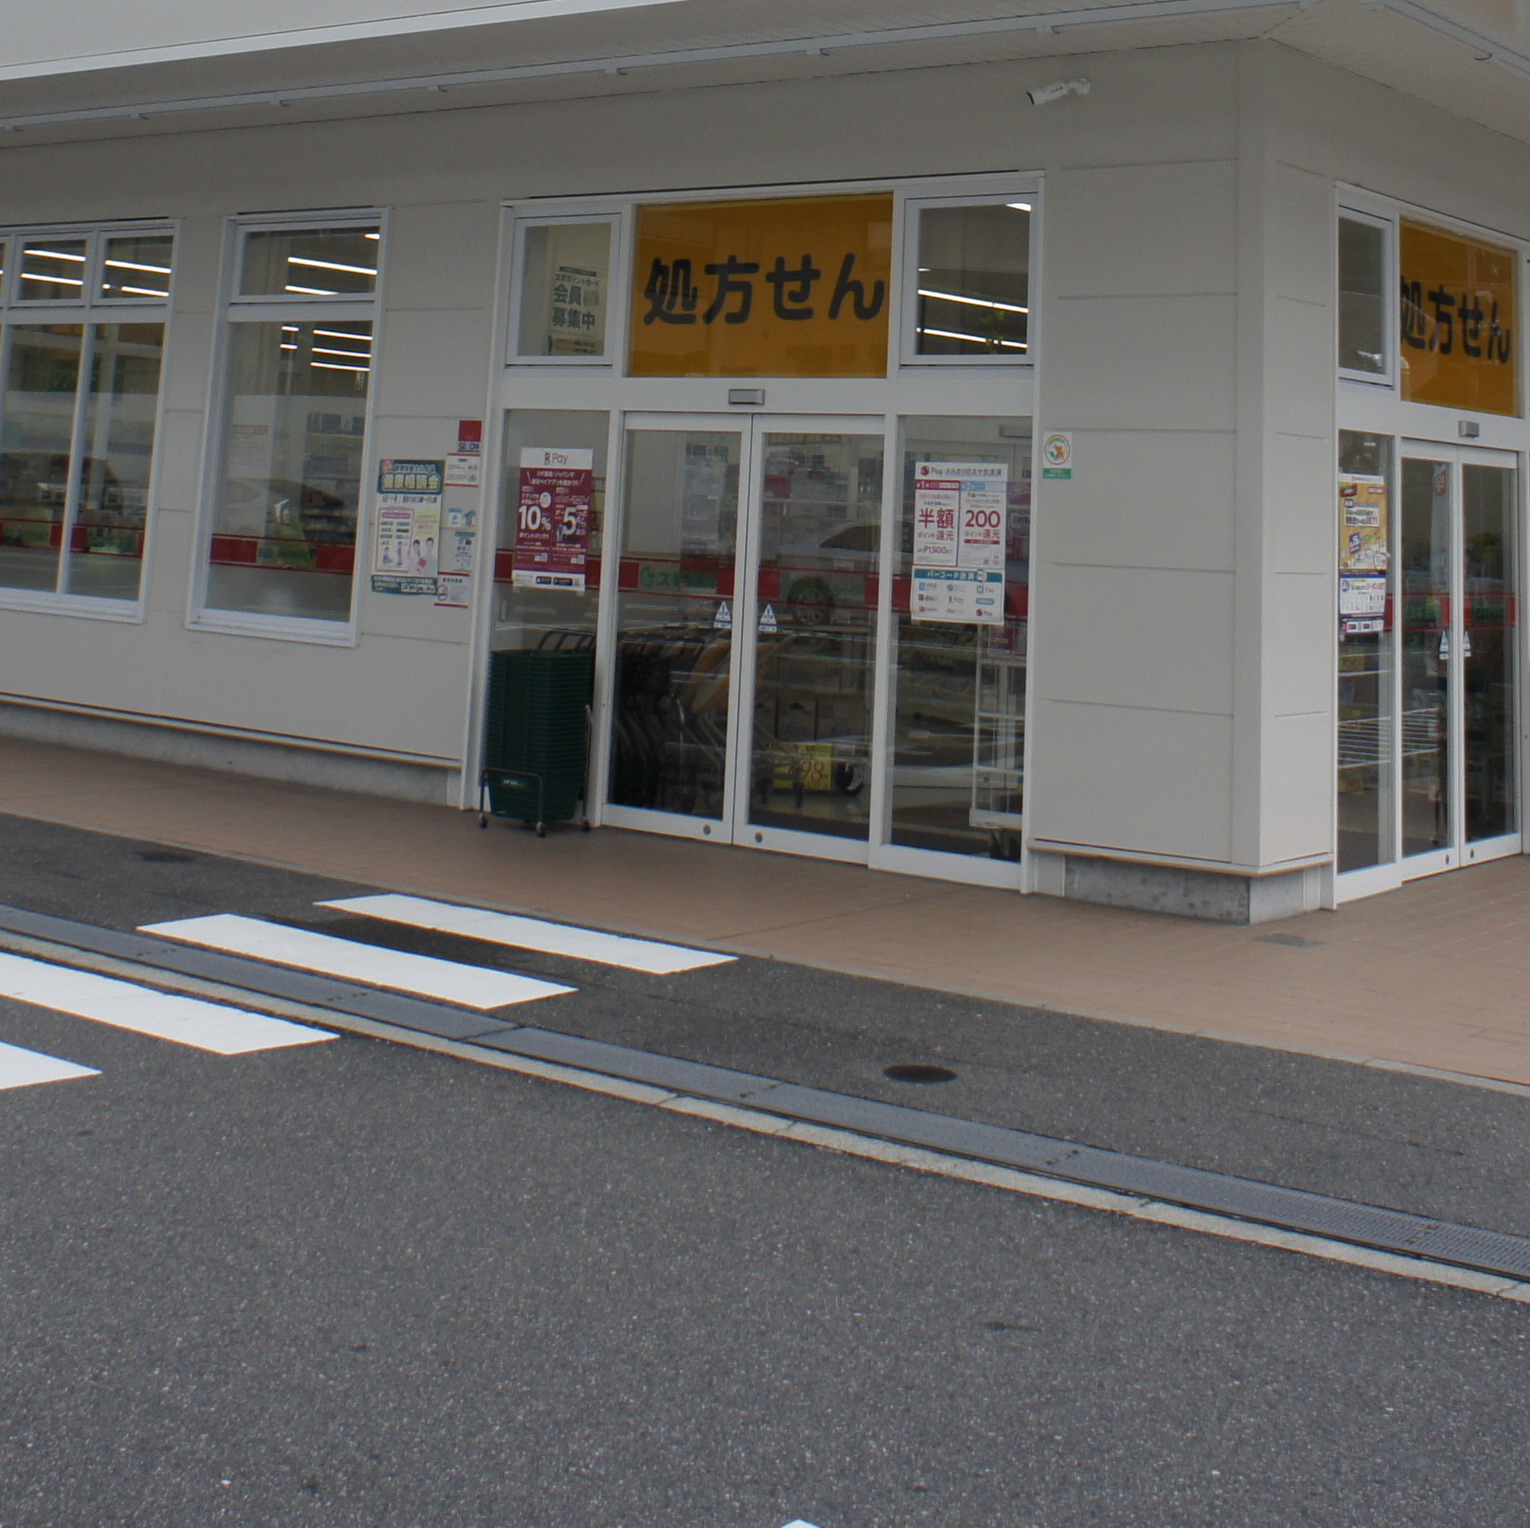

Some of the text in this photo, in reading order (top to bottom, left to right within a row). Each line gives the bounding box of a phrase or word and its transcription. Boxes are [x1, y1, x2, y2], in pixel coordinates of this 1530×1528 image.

[642, 251, 885, 327] 処方せん
[918, 507, 954, 530] 半額
[964, 509, 1001, 528] 200
